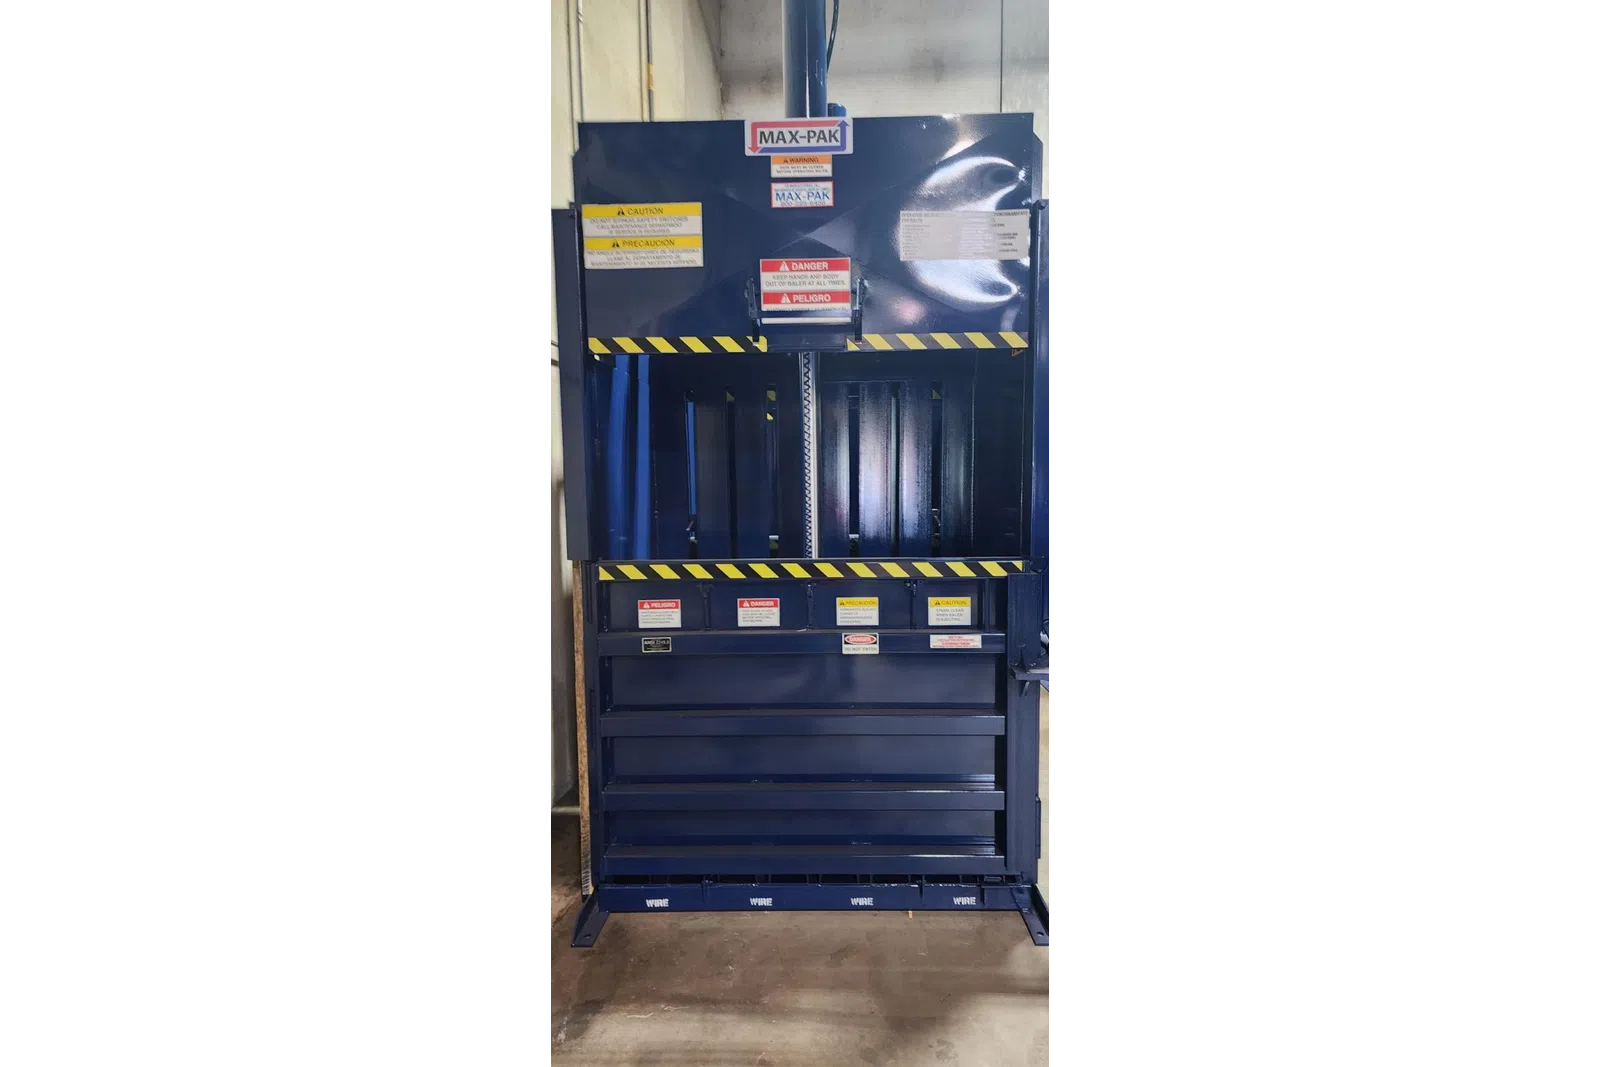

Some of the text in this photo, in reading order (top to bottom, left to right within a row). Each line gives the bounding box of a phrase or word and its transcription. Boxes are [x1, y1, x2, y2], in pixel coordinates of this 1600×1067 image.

[759, 129, 840, 145] MAX-PAK
[775, 191, 831, 201] MAX-PAK
[627, 207, 664, 216] CAUTION
[791, 261, 829, 271] DANGER
[792, 293, 832, 303] PELIGRO
[849, 635, 872, 643] DANGER
[646, 898, 669, 908] WIRE
[750, 897, 773, 907] WIRE
[850, 896, 874, 906] WIRE
[953, 896, 976, 905] WIRE
